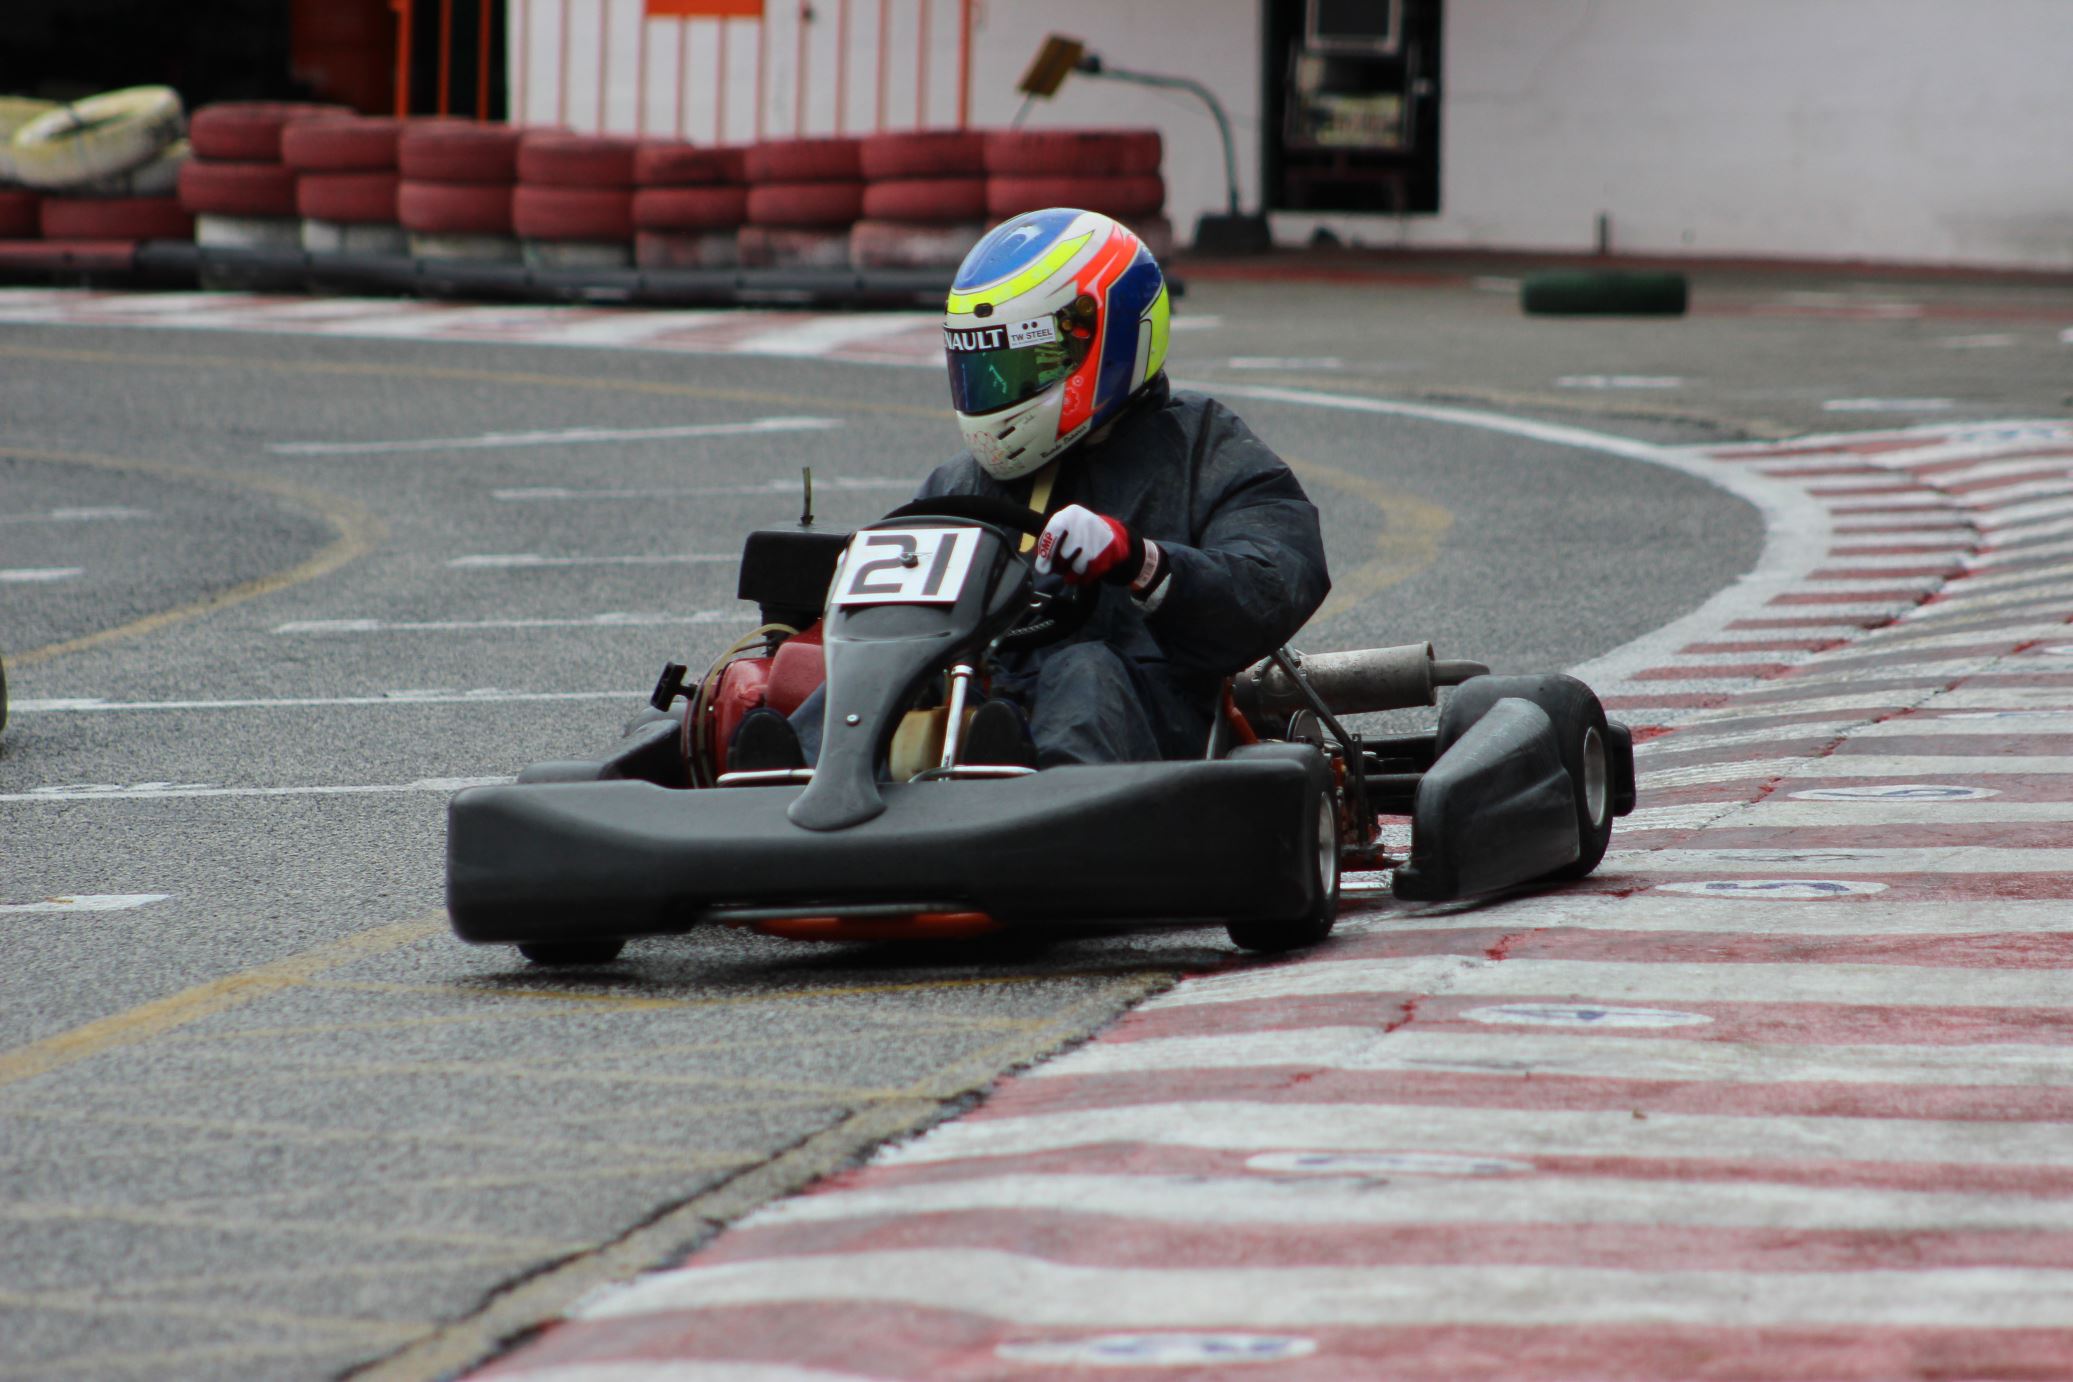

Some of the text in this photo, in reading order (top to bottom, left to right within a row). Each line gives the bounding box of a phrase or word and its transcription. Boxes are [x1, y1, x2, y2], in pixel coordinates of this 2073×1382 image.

[1011, 333, 1025, 342] TW
[1026, 328, 1053, 340] STEEL
[1040, 531, 1053, 558] OMP
[848, 532, 959, 596] 21
